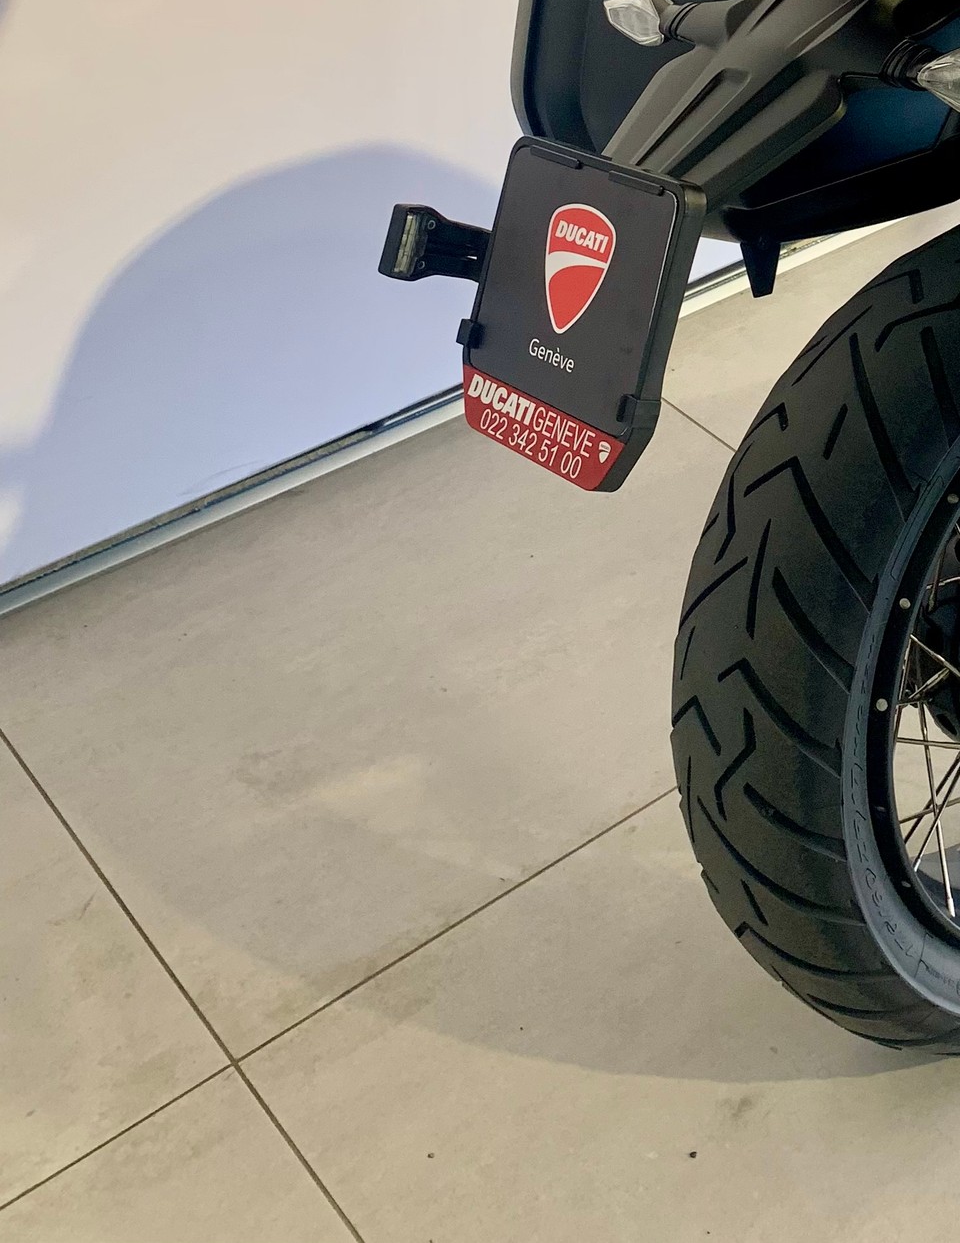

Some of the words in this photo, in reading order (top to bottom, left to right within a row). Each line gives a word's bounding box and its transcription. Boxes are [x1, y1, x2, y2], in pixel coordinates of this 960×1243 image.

[555, 220, 609, 254] DUCATI
[529, 338, 575, 373] Genève
[480, 408, 508, 440] 022
[508, 424, 538, 456] 342
[538, 438, 559, 467] 51
[560, 451, 582, 479] 00
